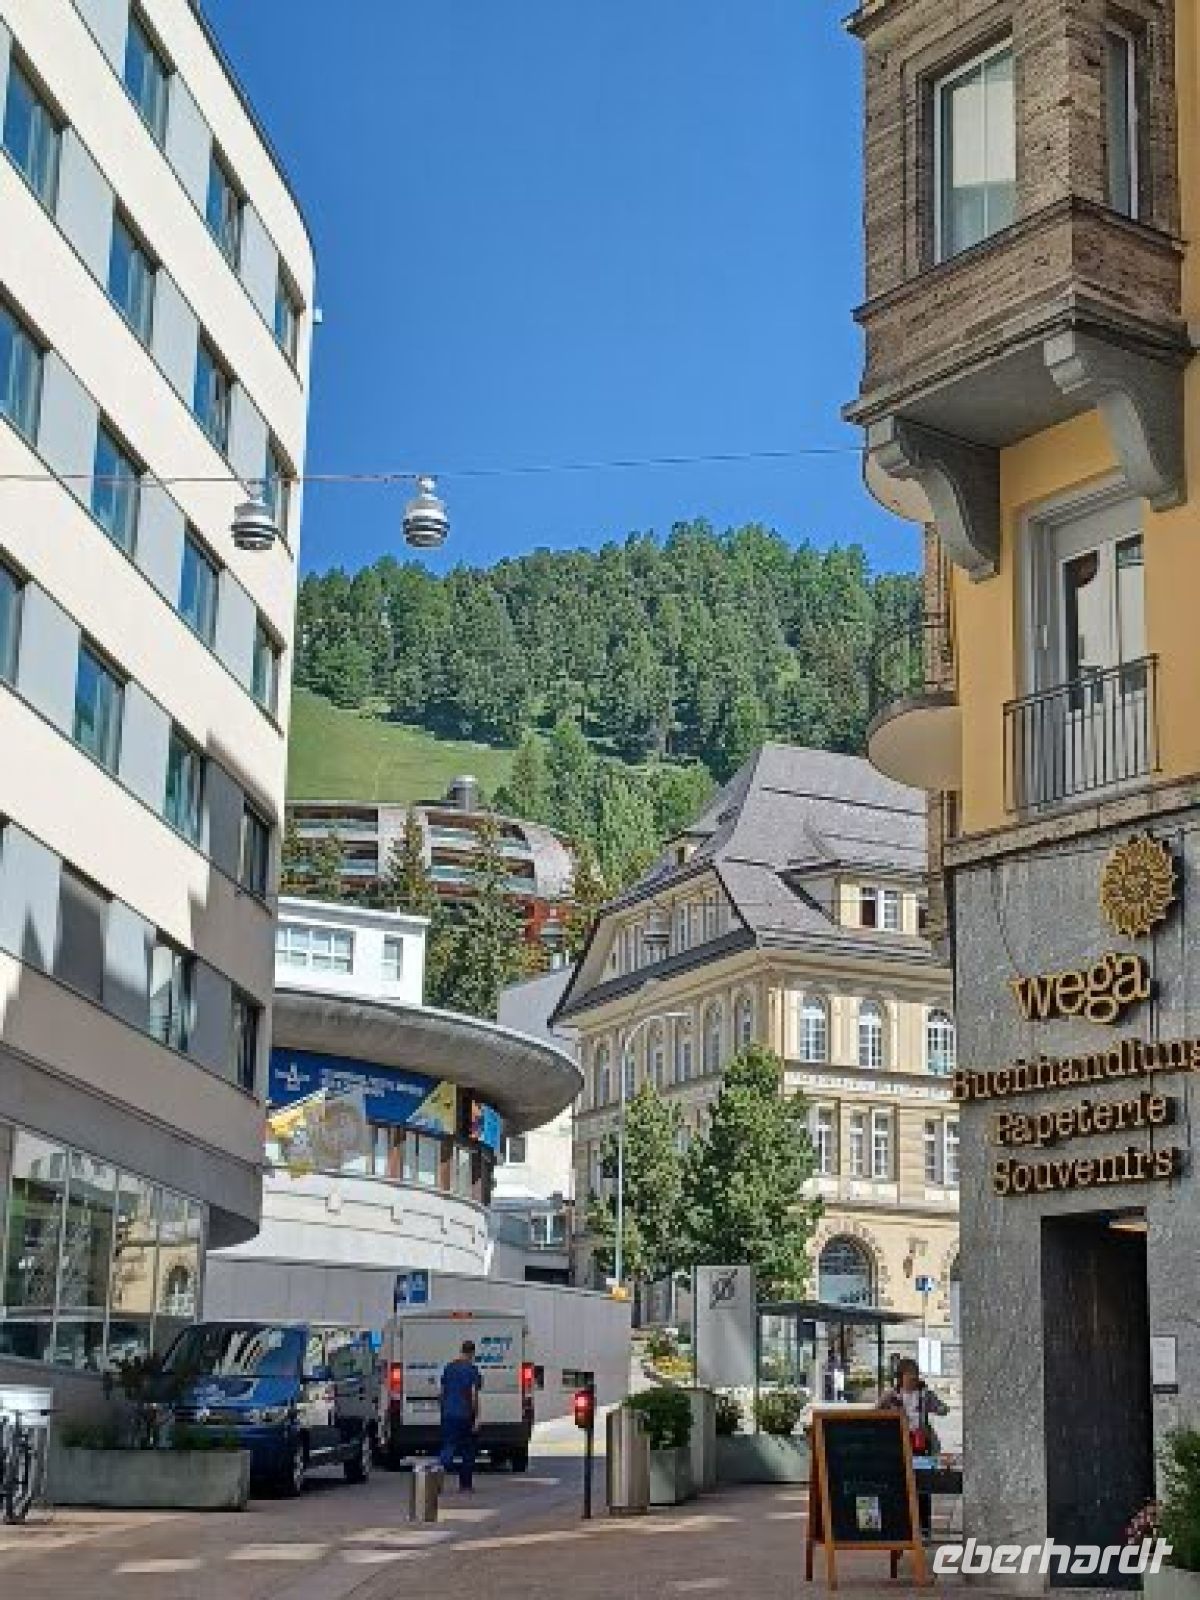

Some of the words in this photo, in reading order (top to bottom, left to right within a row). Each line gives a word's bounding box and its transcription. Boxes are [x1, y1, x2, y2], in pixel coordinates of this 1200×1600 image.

[1009, 952, 1151, 1024] wega
[994, 1092, 1168, 1147] Papeterie
[992, 1147, 1174, 1196] Souvenirs
